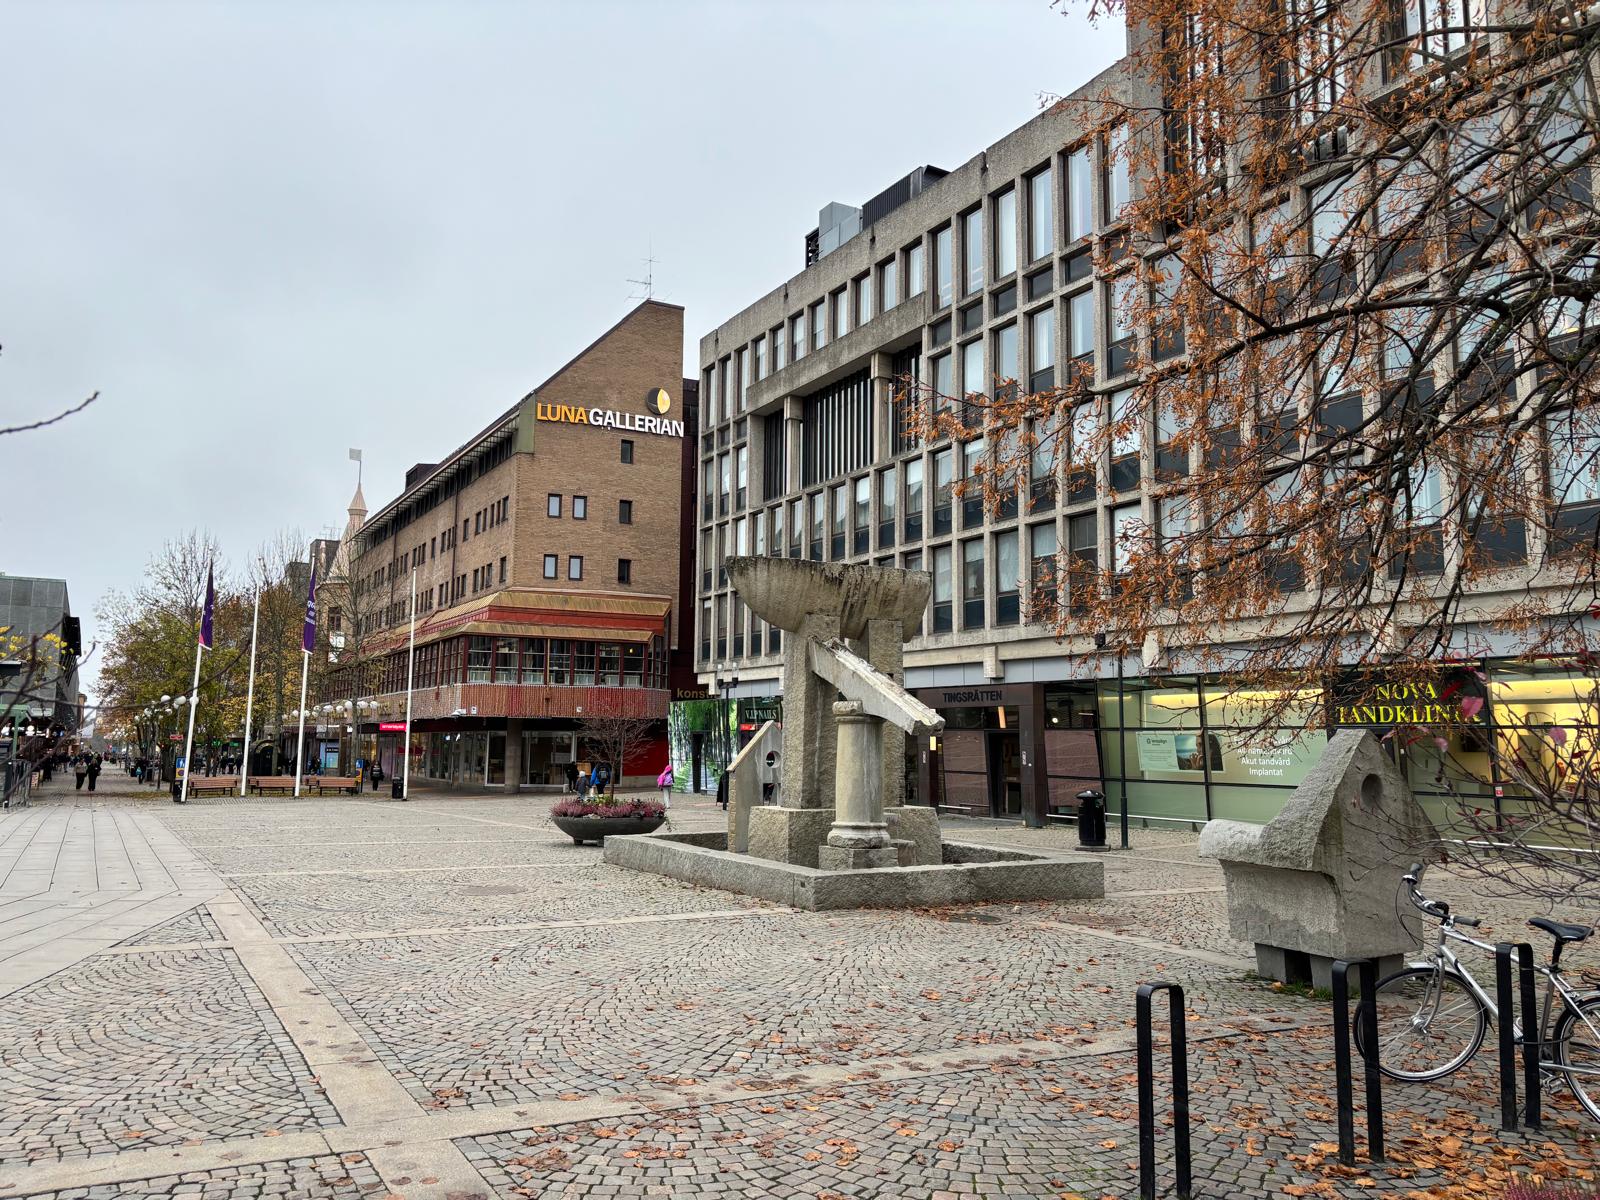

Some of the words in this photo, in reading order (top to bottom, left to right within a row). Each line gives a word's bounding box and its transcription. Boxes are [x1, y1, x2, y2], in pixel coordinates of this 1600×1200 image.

[943, 689, 1003, 703] TINGSRÄTTEN
[1375, 681, 1438, 700] NOVA
[1241, 756, 1258, 765] Akut
[1258, 757, 1291, 766] tandvård
[1249, 767, 1283, 777] Implantat
